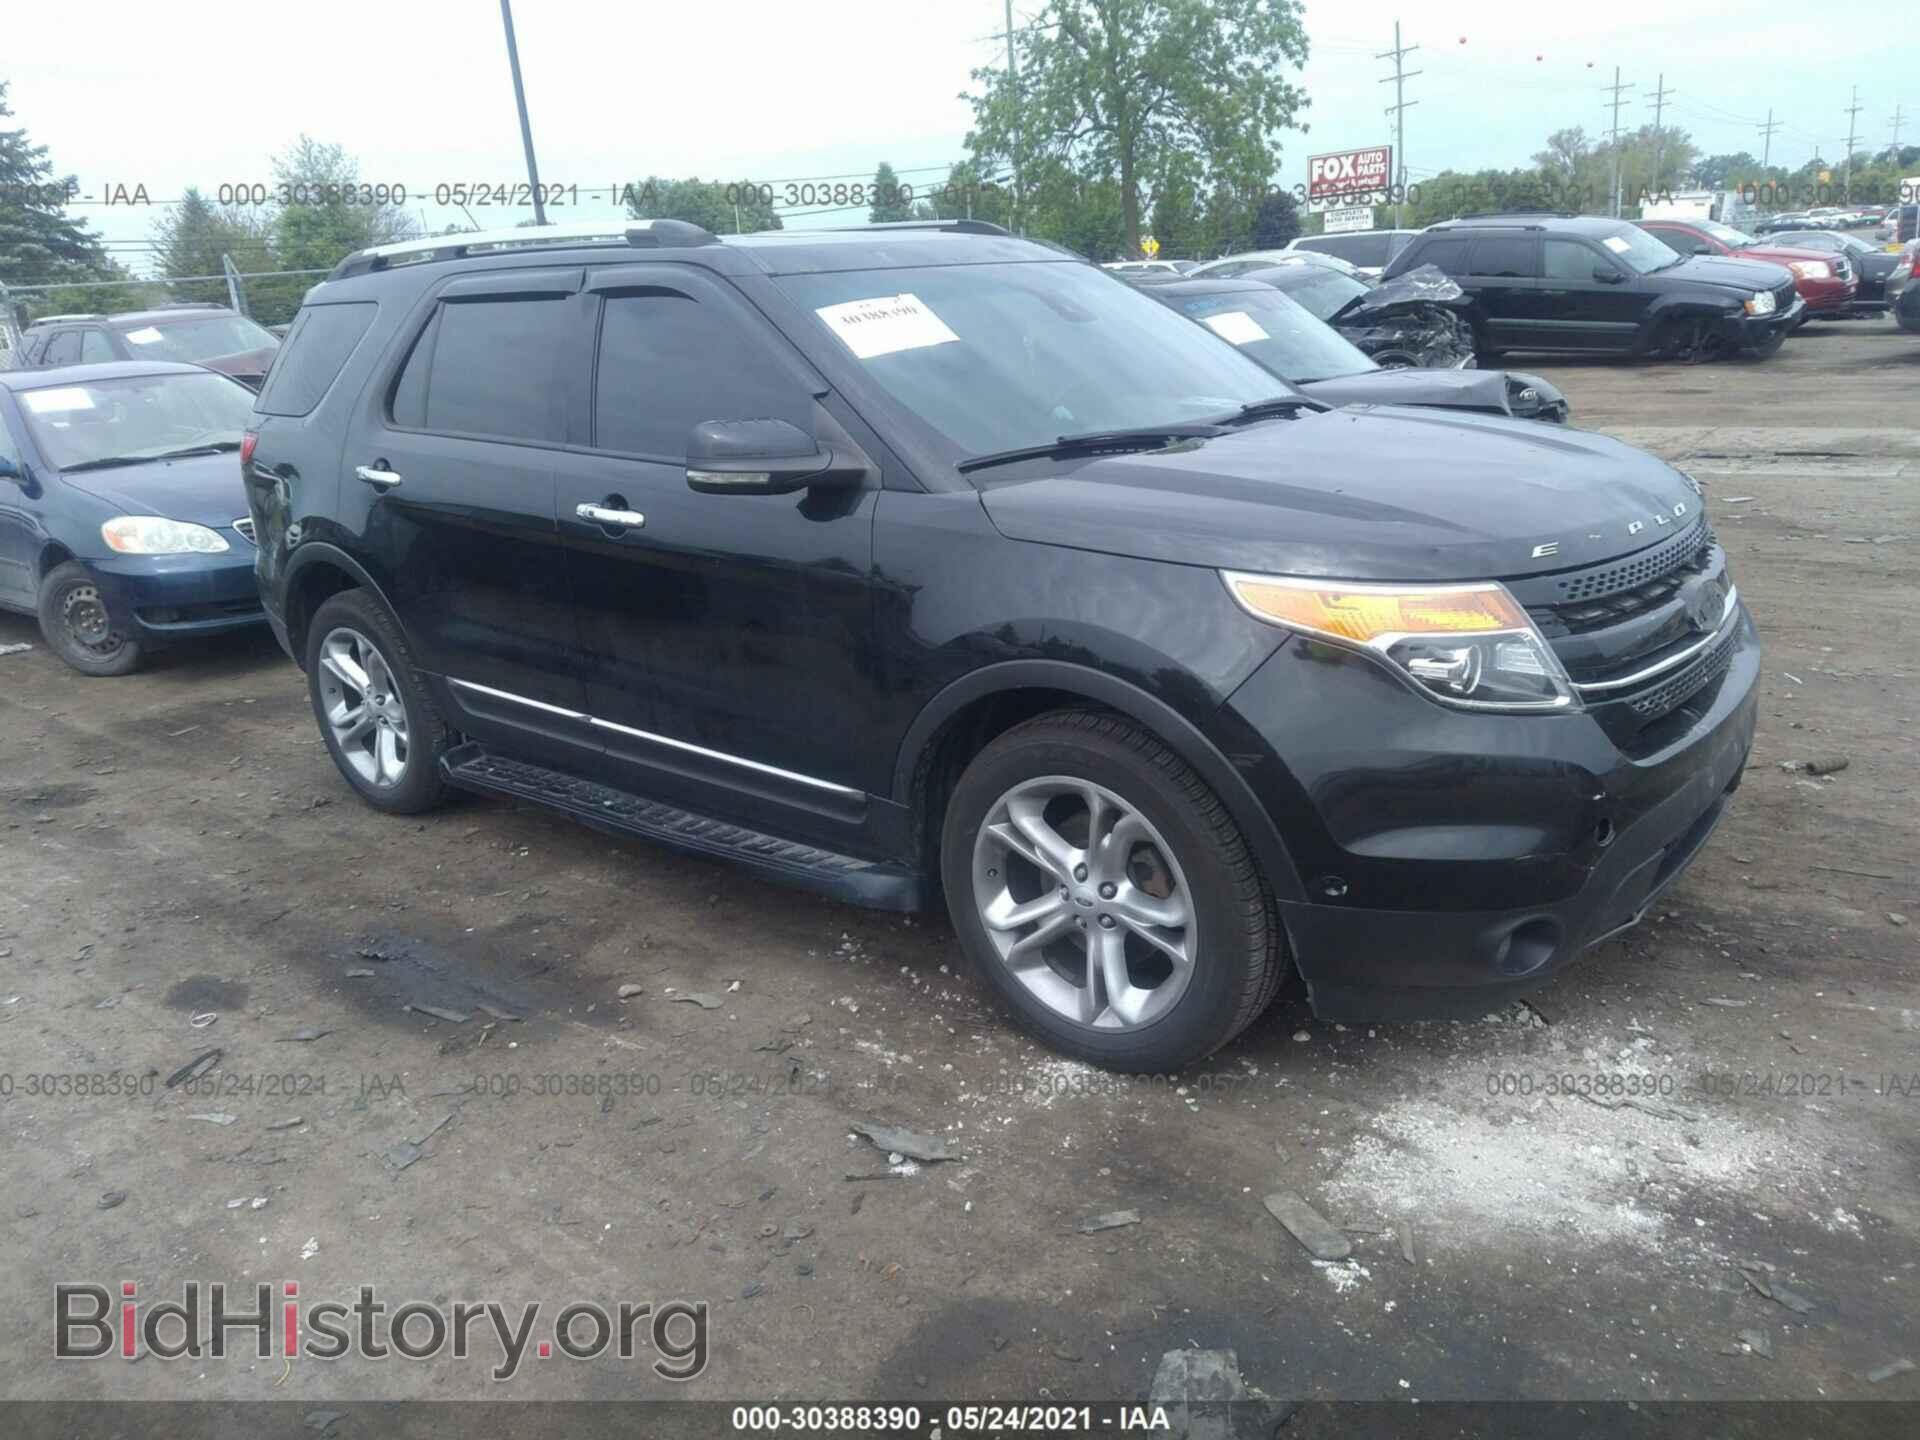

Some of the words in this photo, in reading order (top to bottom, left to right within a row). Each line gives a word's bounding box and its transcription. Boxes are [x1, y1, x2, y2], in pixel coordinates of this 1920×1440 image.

[1358, 151, 1384, 164] AUTO
[1312, 155, 1356, 182] FOX
[1357, 163, 1386, 177] PARTS
